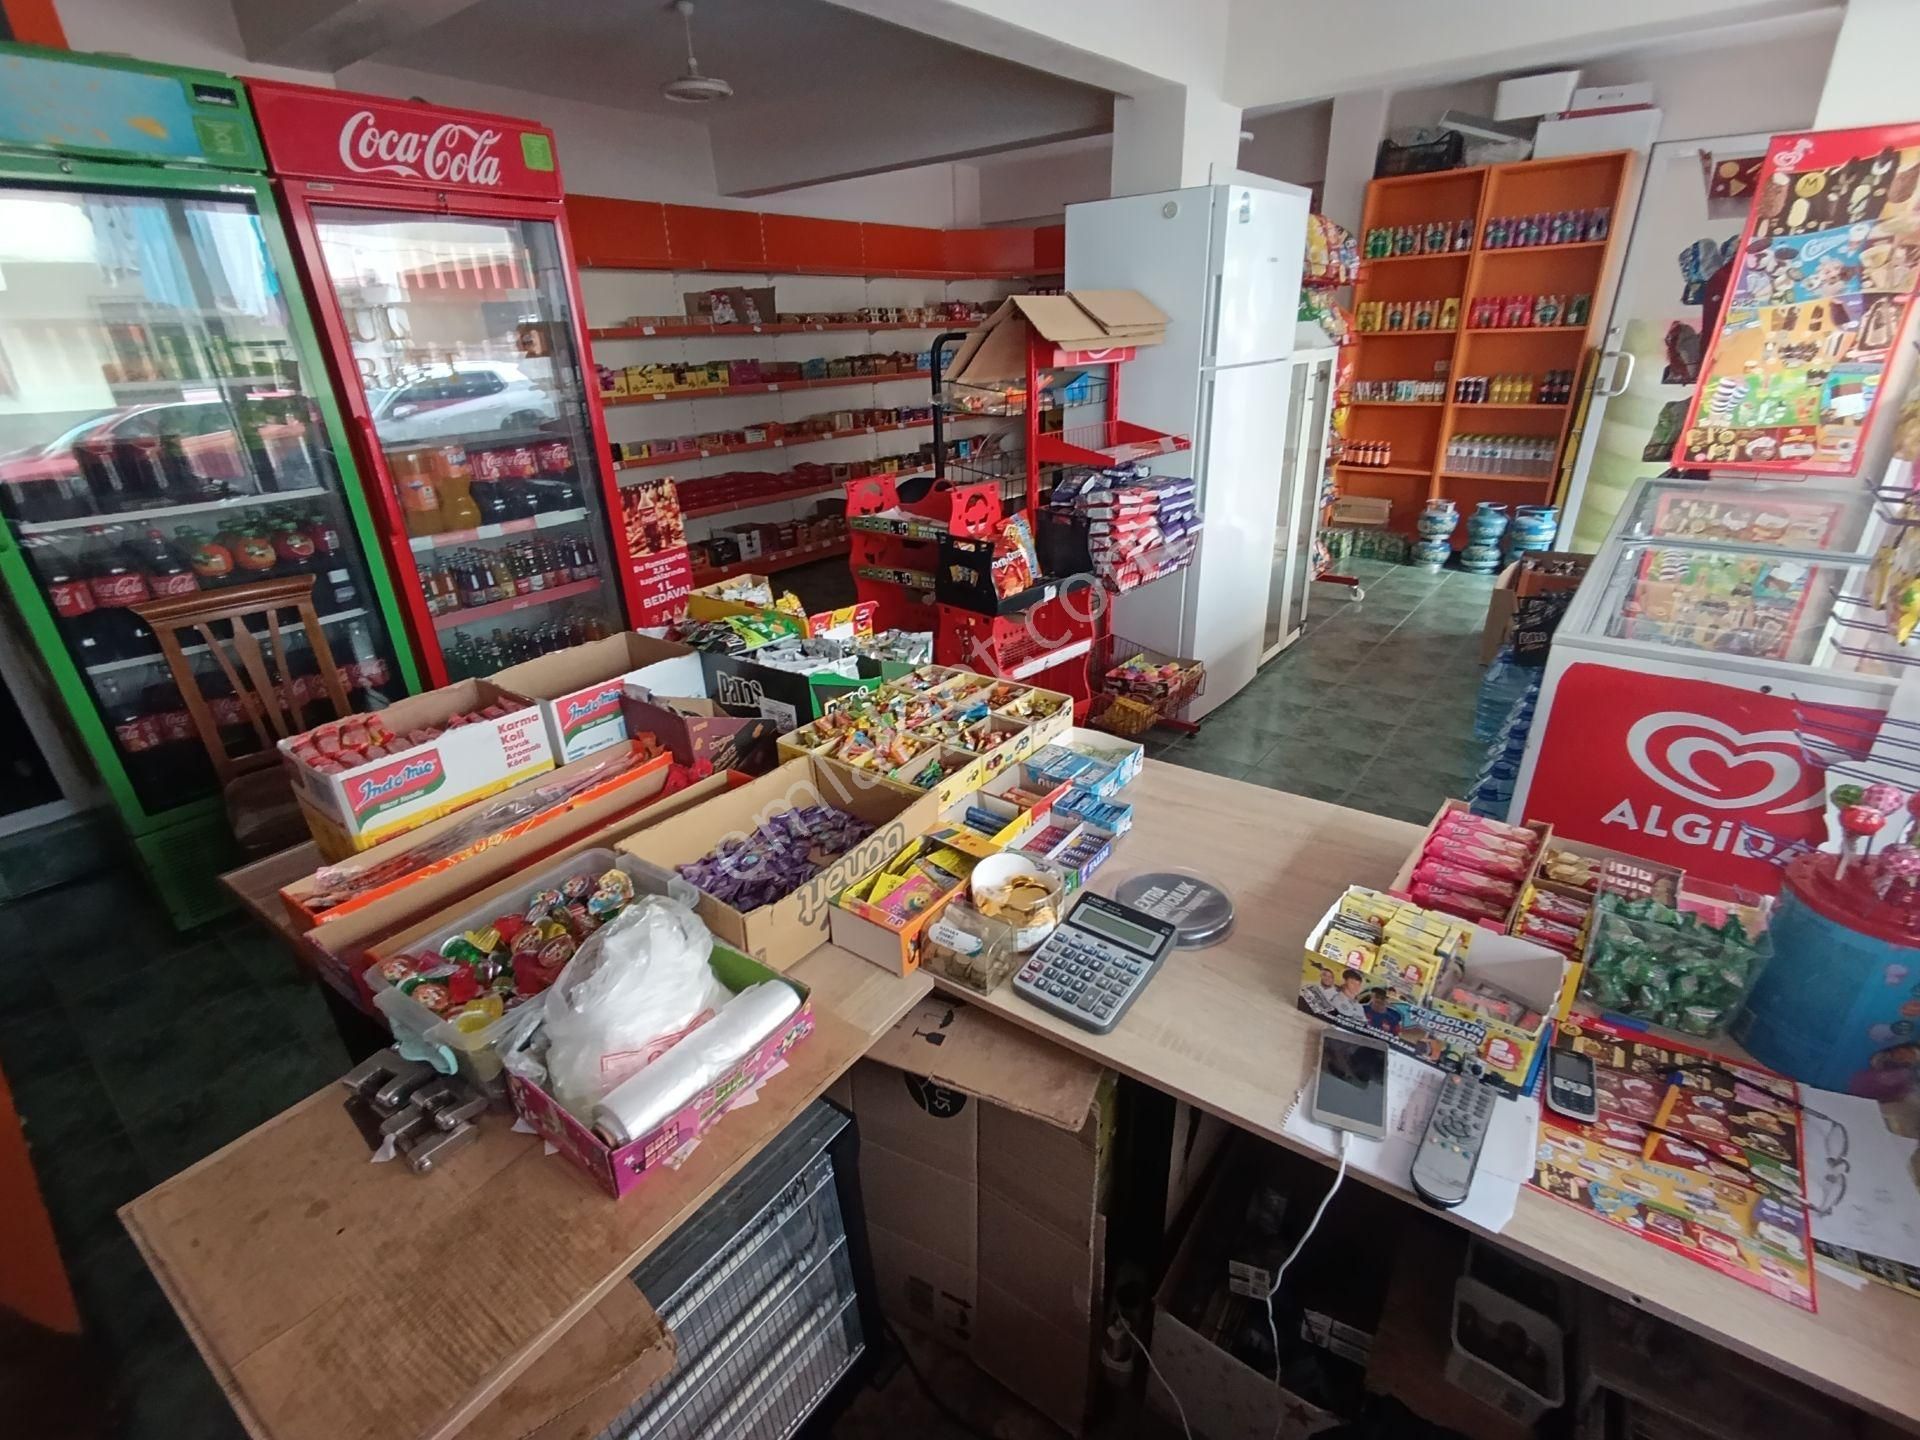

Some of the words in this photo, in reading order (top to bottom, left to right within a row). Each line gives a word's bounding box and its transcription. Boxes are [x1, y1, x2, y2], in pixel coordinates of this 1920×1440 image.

[339, 111, 502, 186] Coca-Cola
[643, 584, 690, 608] BEDAVA!
[657, 583, 664, 592] 1
[665, 581, 673, 590] L
[497, 713, 539, 734] Karma
[500, 731, 525, 746] Koli
[503, 739, 529, 753] Tavuk
[1134, 886, 1168, 910] EXTRA
[1410, 1006, 1486, 1037] FUTBOLUN
